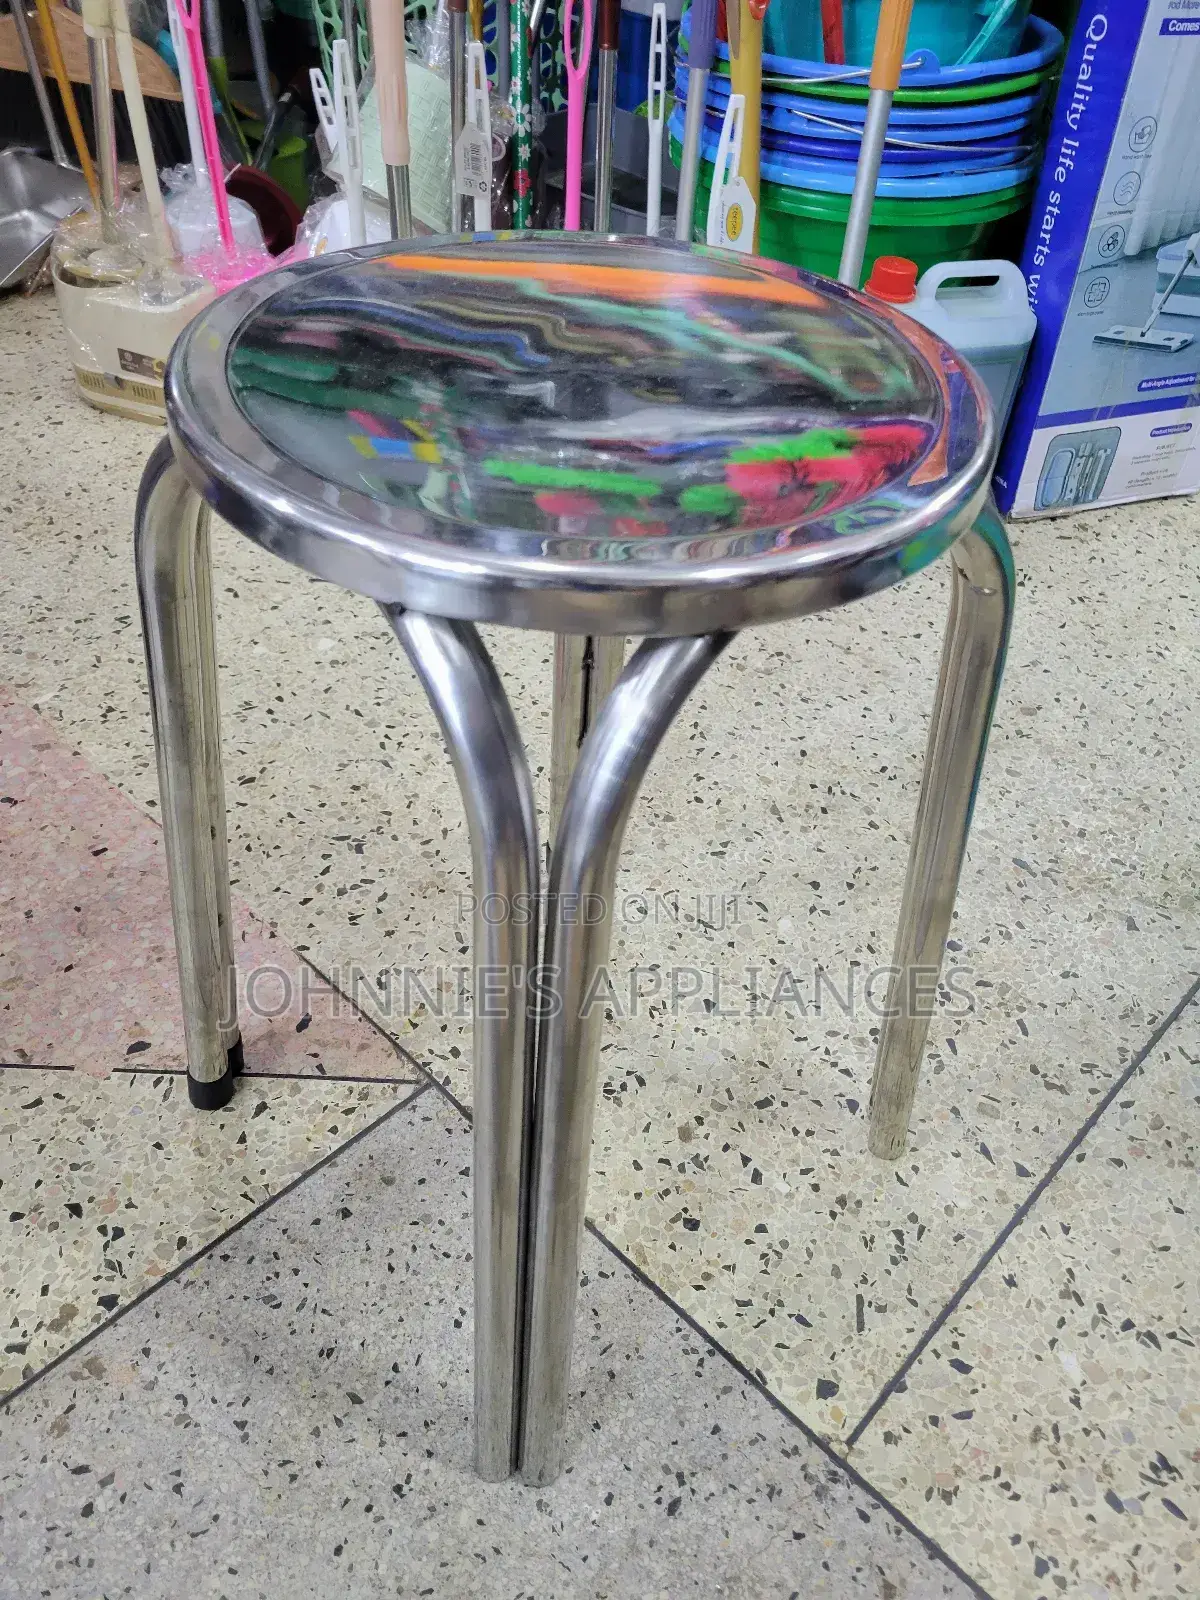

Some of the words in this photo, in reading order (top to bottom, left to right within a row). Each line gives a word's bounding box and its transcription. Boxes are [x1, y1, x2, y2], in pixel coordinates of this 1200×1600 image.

[1169, 20, 1200, 31] Comes
[1066, 14, 1108, 131] Quality
[1054, 137, 1080, 183] life
[1034, 190, 1061, 267] starts
